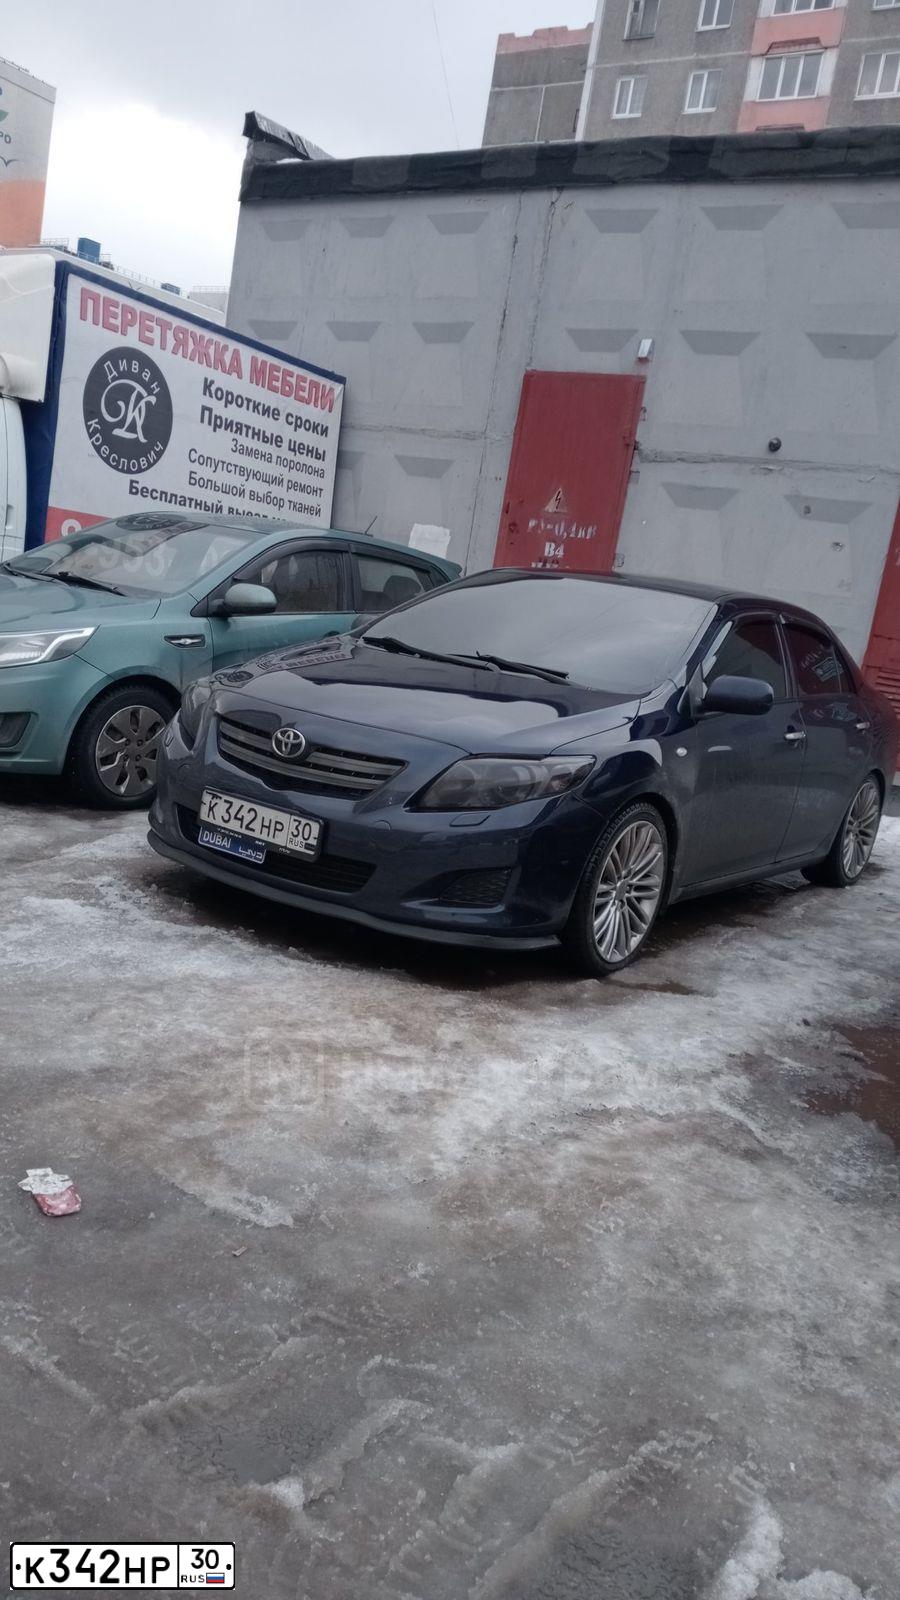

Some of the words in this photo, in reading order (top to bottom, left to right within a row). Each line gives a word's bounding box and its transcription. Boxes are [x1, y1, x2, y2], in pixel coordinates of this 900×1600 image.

[80, 287, 243, 380] ПЕРЕТЯЖКА
[249, 355, 336, 413] МЕБЕЛИ
[104, 359, 160, 394] Диван
[202, 377, 281, 421] Короткие
[285, 411, 329, 438] сроки
[87, 418, 164, 472] Креслович
[200, 405, 284, 448] Приятные
[288, 435, 326, 462] цены
[188, 448, 284, 488] Сопутствующий
[287, 478, 324, 498] ремонт
[231, 438, 273, 463] Замена
[276, 454, 325, 479] поролона
[129, 479, 223, 514] Бесплатный
[188, 471, 246, 498] Большой
[249, 488, 285, 511] выбор
[287, 499, 322, 518] тканей
[203, 831, 231, 848] DUBAI
[288, 837, 304, 849] RUS
[291, 818, 312, 841] 30
